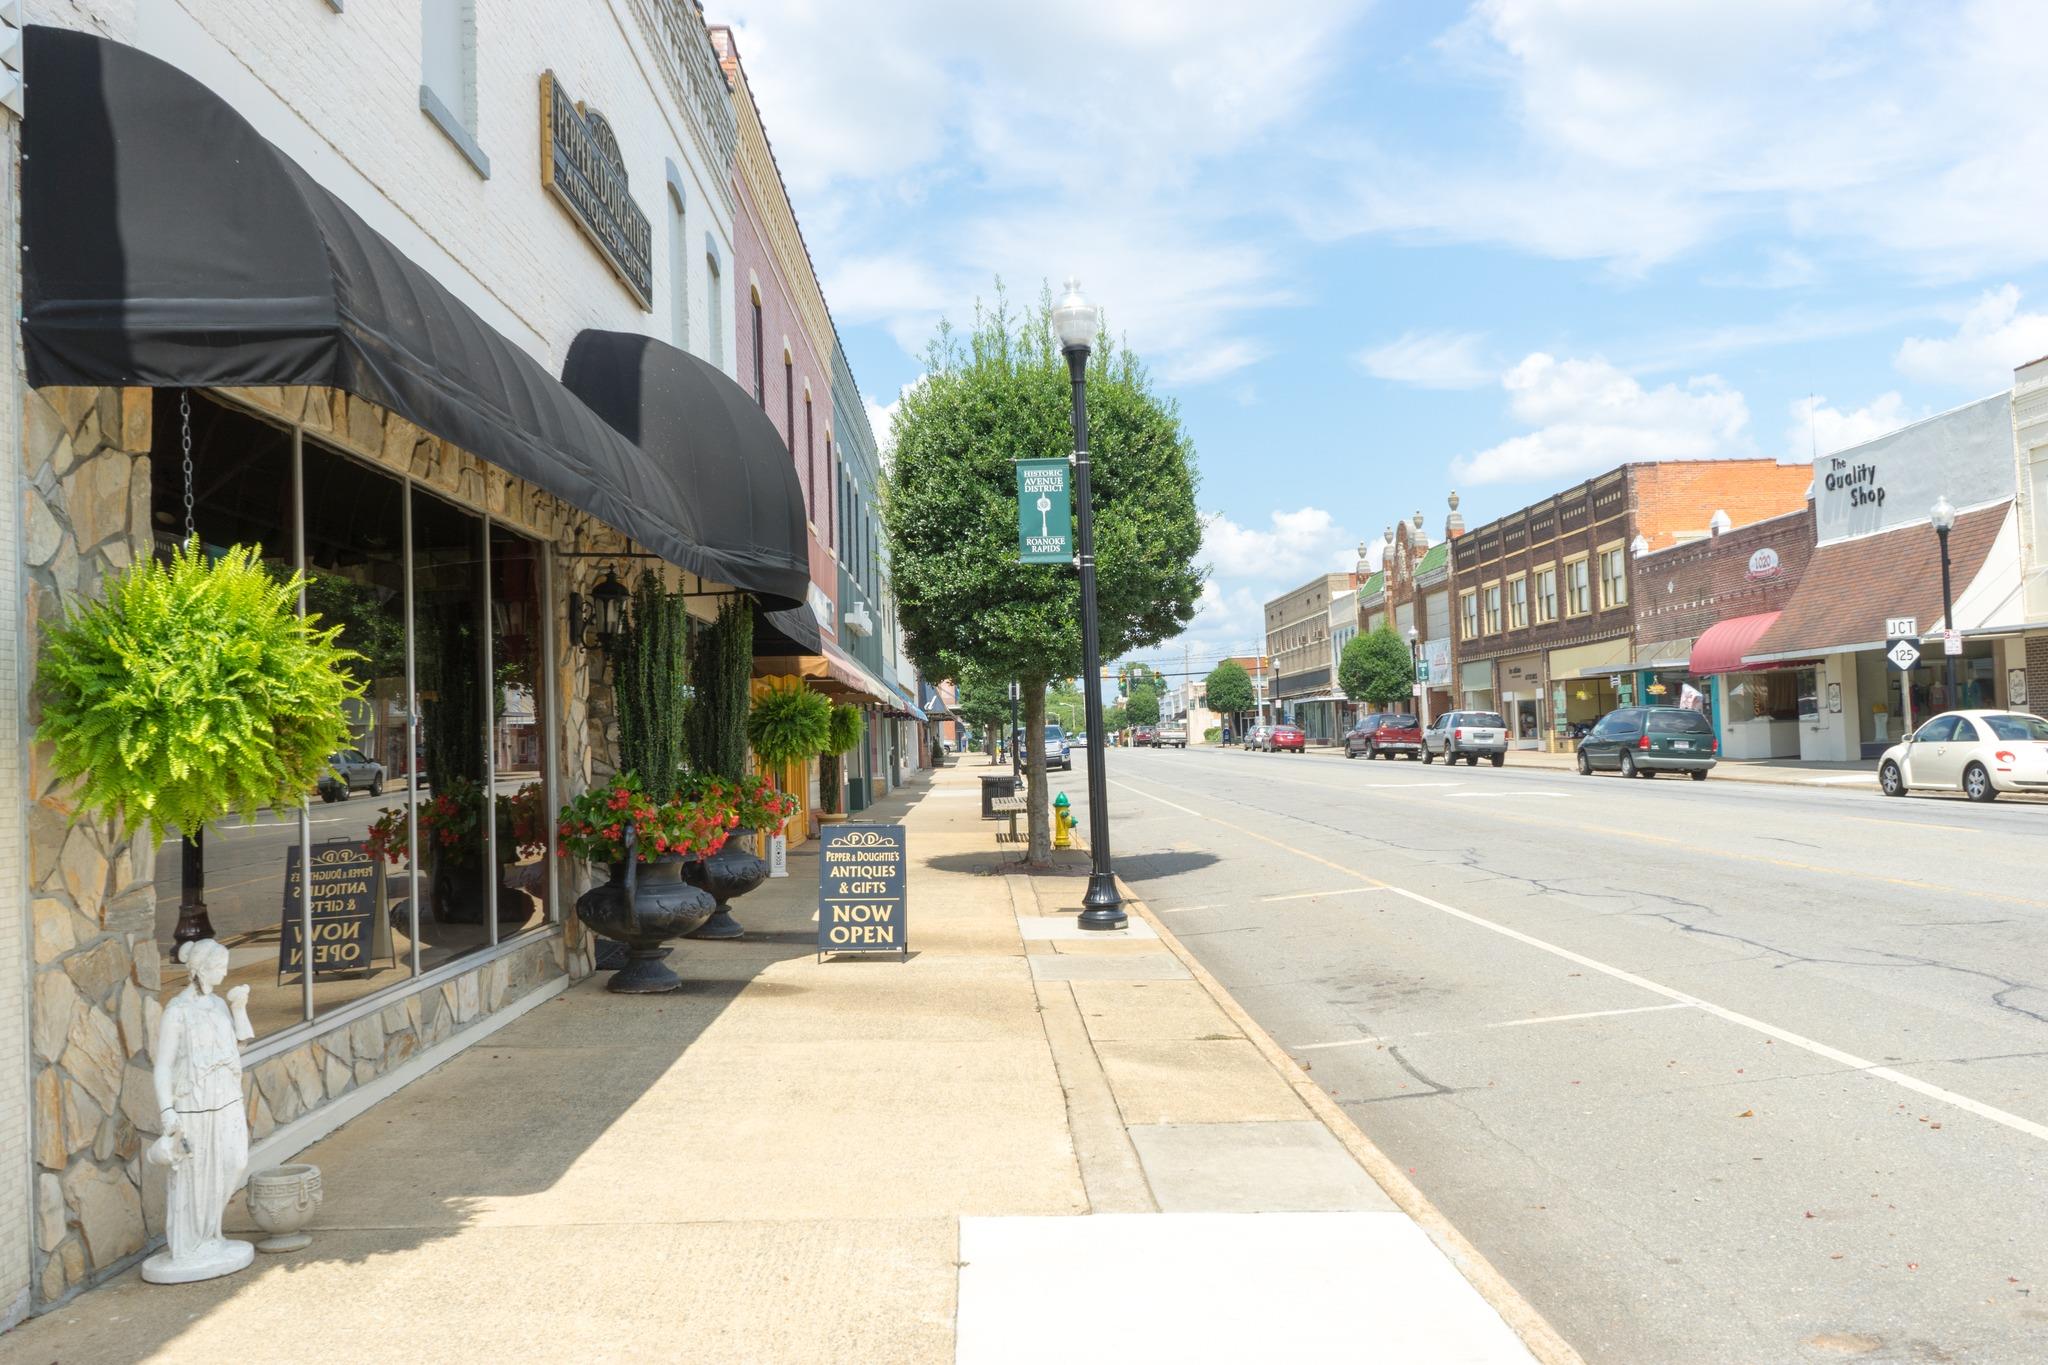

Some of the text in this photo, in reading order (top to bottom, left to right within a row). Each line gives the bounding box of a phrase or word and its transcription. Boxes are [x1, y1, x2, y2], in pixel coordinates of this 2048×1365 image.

[557, 94, 650, 265] PEPPER & DOUGHTIE'S
[565, 163, 618, 249] ANTIQUES
[623, 245, 646, 288] GIFTS
[1831, 458, 1846, 471] The
[1024, 469, 1063, 477] HISTORIC
[1825, 463, 1876, 491] Quality
[1024, 477, 1063, 485] AVENUE
[1024, 485, 1063, 493] DISTRICT
[1851, 486, 1885, 507] Shop
[1026, 537, 1066, 546] ROANOKE
[1032, 545, 1061, 553] RAPIDS
[1890, 621, 1914, 635] JCT
[1895, 649, 1914, 661] 125
[852, 835, 876, 845] P D
[826, 851, 851, 862] PEPPER
[857, 851, 900, 862] DOUGHTIE'S
[830, 865, 896, 879] ANTIQUES
[839, 881, 887, 894] & GIFTS
[832, 905, 893, 922] NOW
[829, 926, 894, 944] OPEN
